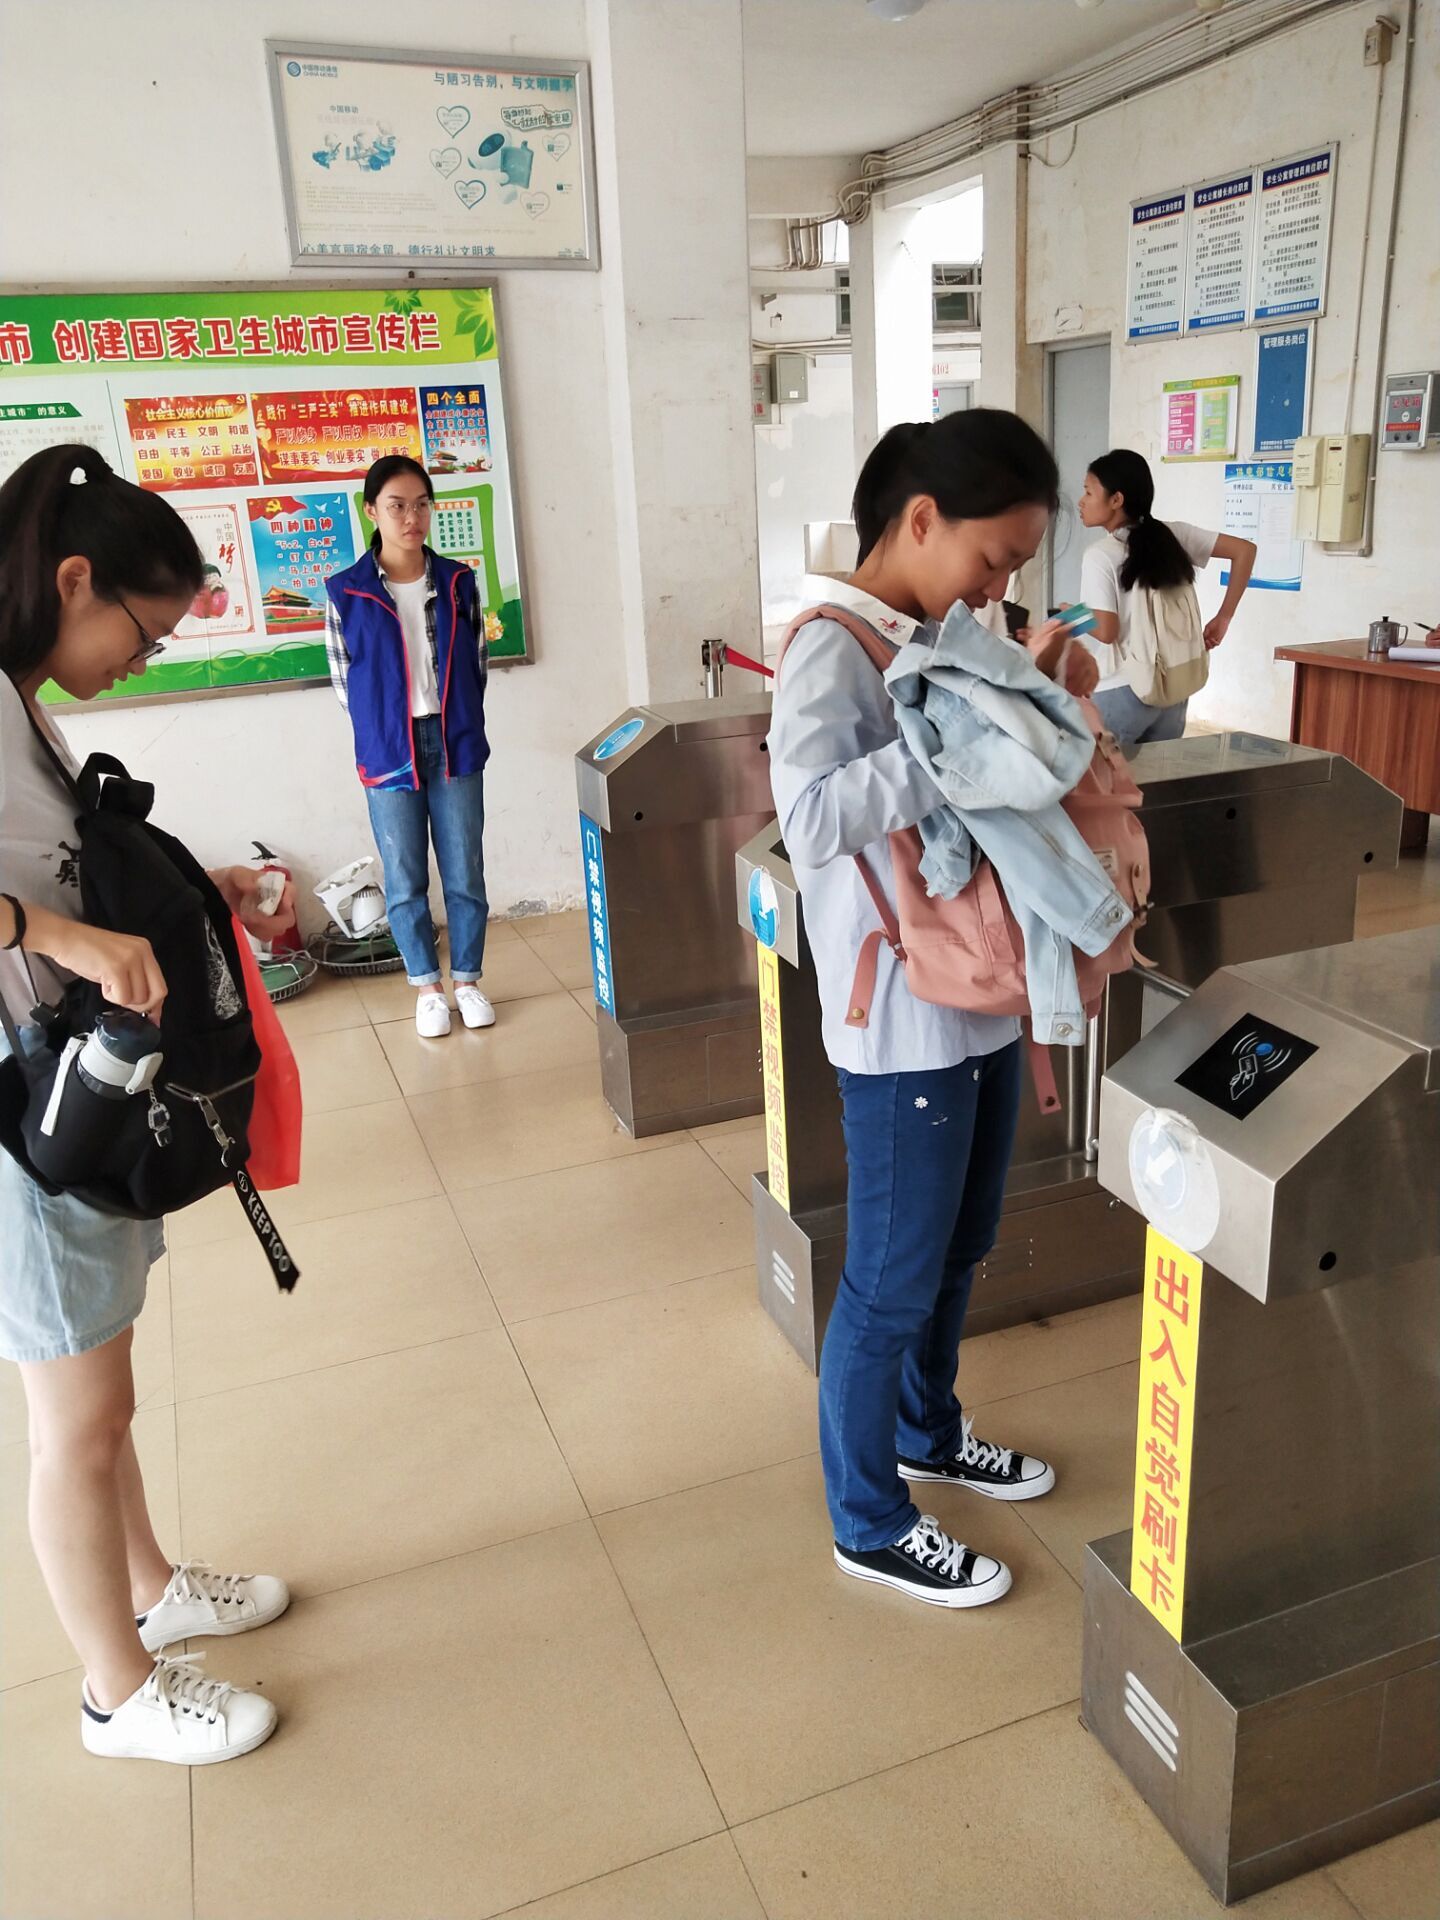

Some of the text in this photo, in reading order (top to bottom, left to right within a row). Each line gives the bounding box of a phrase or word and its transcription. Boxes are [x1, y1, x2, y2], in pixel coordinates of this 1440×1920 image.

[1266, 159, 1328, 186] 学生公寓管理员岗位职责
[0, 311, 442, 364] 市 创建国家卫生城市宣传栏
[1263, 333, 1307, 349] 管理服务岗位
[426, 390, 480, 406] 四个全面
[37, 406, 67, 416] 的意义
[145, 404, 234, 422] 社会主义核心价值观
[265, 405, 287, 420] 践行
[349, 399, 409, 417] 推进作风建设
[134, 424, 249, 441] 富强 民主 文明 和谐
[275, 423, 408, 445] 严以修身 严以用权 严以律己
[138, 443, 252, 460] 自由 平等 公正 法治
[279, 451, 320, 467] 谋事要实
[325, 448, 366, 465] 创业要实
[141, 463, 255, 480] 爱国 敬业 诚信 友善
[270, 517, 333, 534] 四种精神
[586, 828, 611, 1005] 门禁视频监控
[761, 959, 787, 1201] 门禁视频监控
[247, 1191, 272, 1235] KEEP
[1139, 1254, 1190, 1613] 出入自觉刷卡
